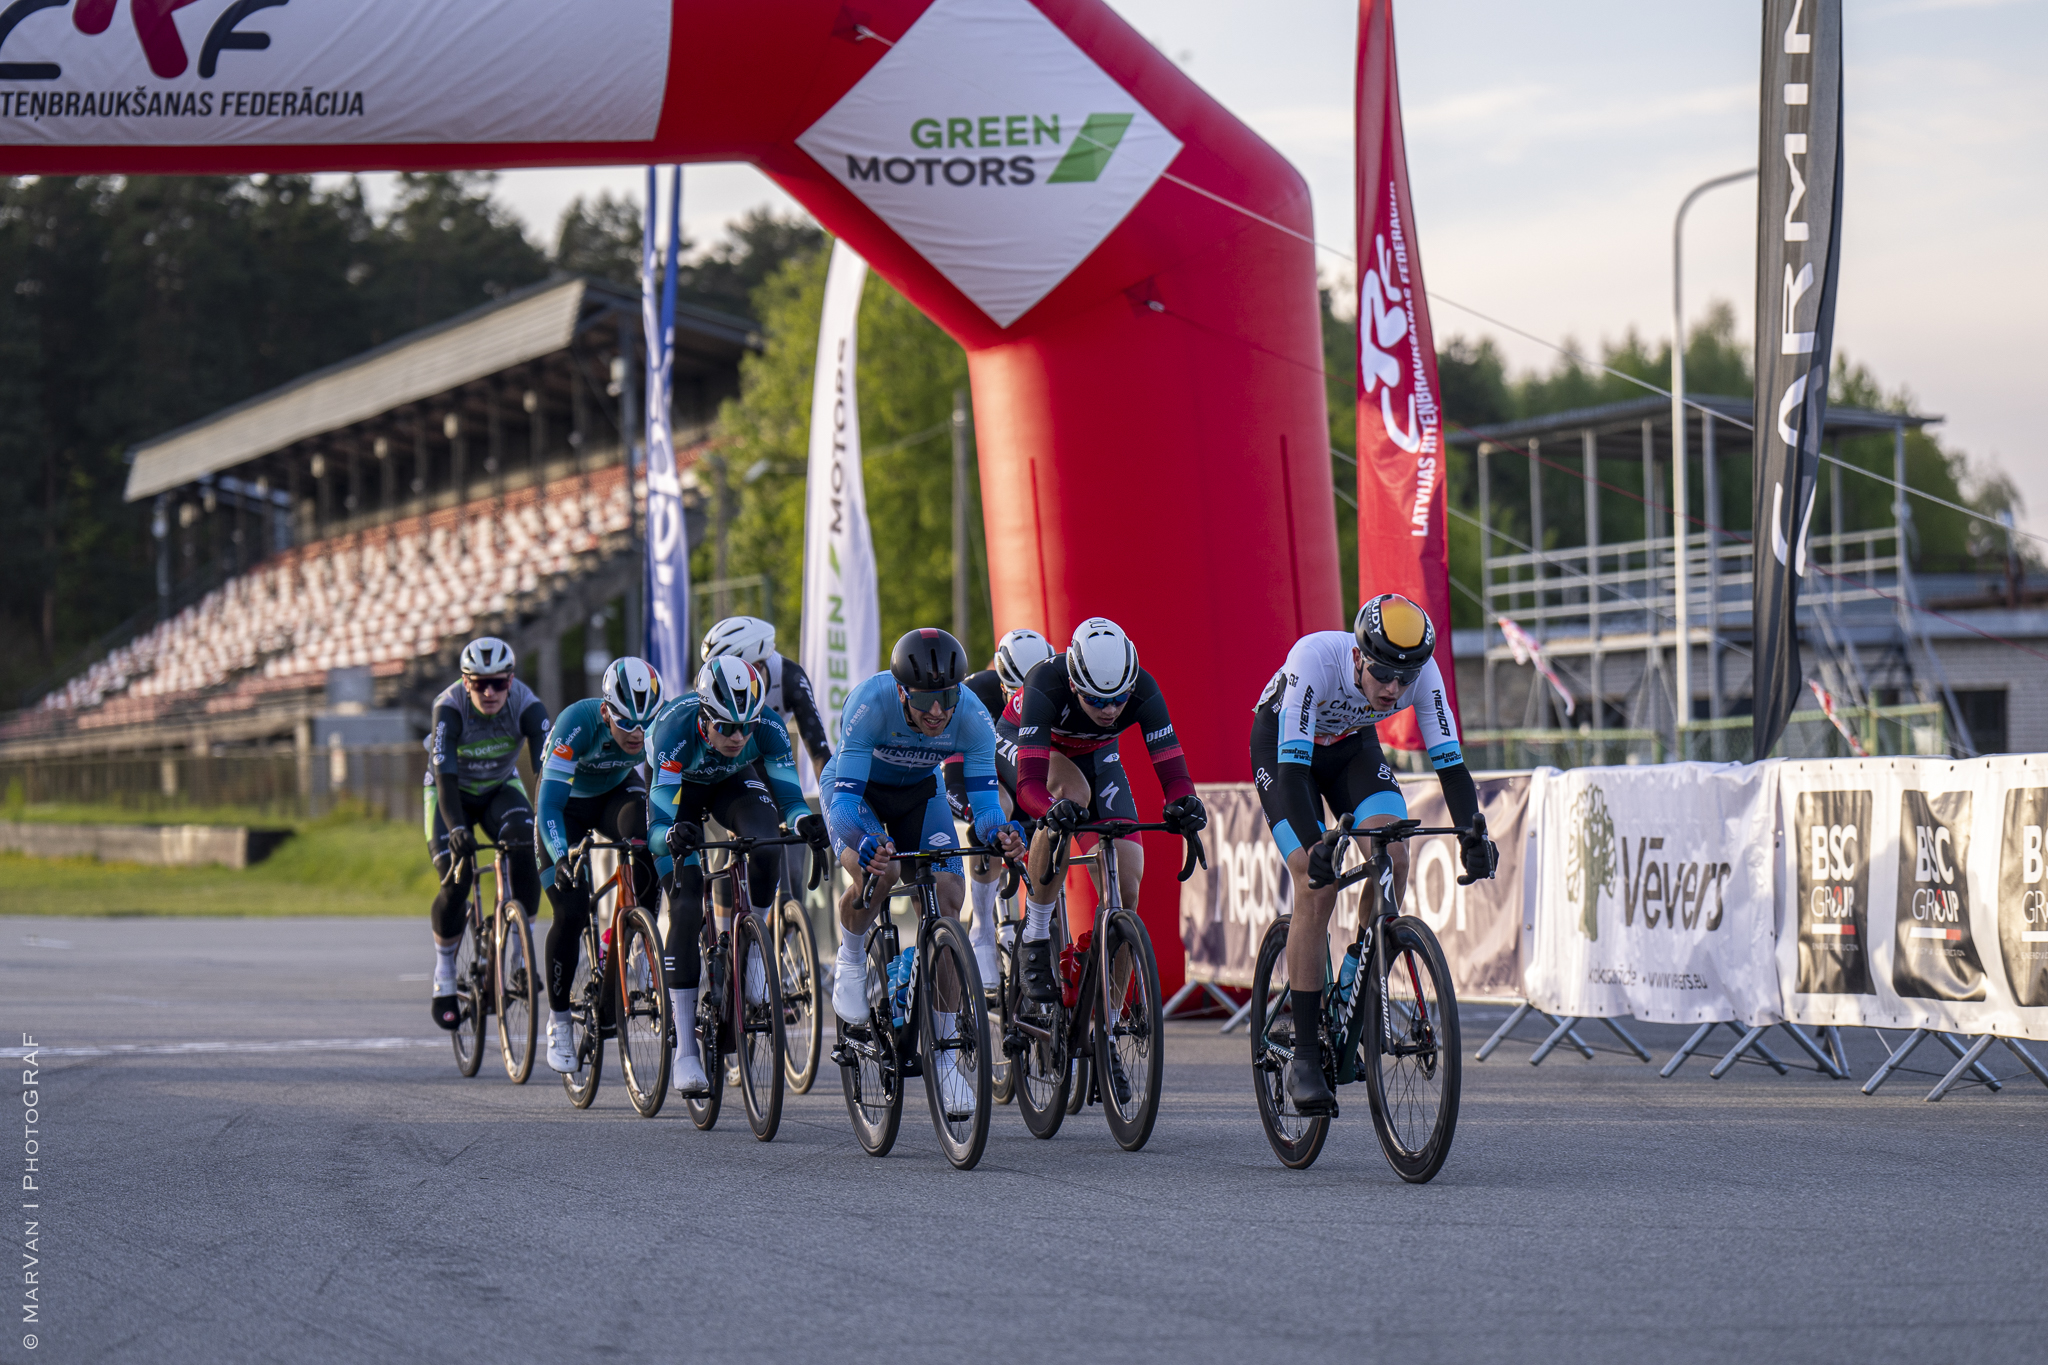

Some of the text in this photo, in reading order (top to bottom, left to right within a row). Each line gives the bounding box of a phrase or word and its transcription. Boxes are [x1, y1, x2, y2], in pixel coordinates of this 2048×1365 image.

[220, 86, 364, 117] FEDERĀCIJA
[910, 114, 1060, 149] GREEN
[846, 154, 1036, 187] MOTORS
[1411, 457, 1437, 537] LATVIJAS
[1371, 598, 1383, 636] RUDY
[1299, 685, 1315, 736] MERIDA
[1431, 689, 1452, 737] MERIDA
[760, 717, 791, 748] ENERGUS
[1018, 726, 1039, 738] ION
[1146, 723, 1174, 743] DION
[546, 819, 565, 858] ENERGUS
[1811, 824, 1858, 881] BSC
[1915, 825, 1955, 885] BSC
[2022, 824, 2048, 884] B
[1621, 836, 1732, 932] Vēvers
[1811, 885, 1855, 918] GROUP
[1912, 888, 1960, 923] GROUP
[2021, 890, 2048, 924] GR
[1379, 974, 1392, 1039] SPECIALIZED
